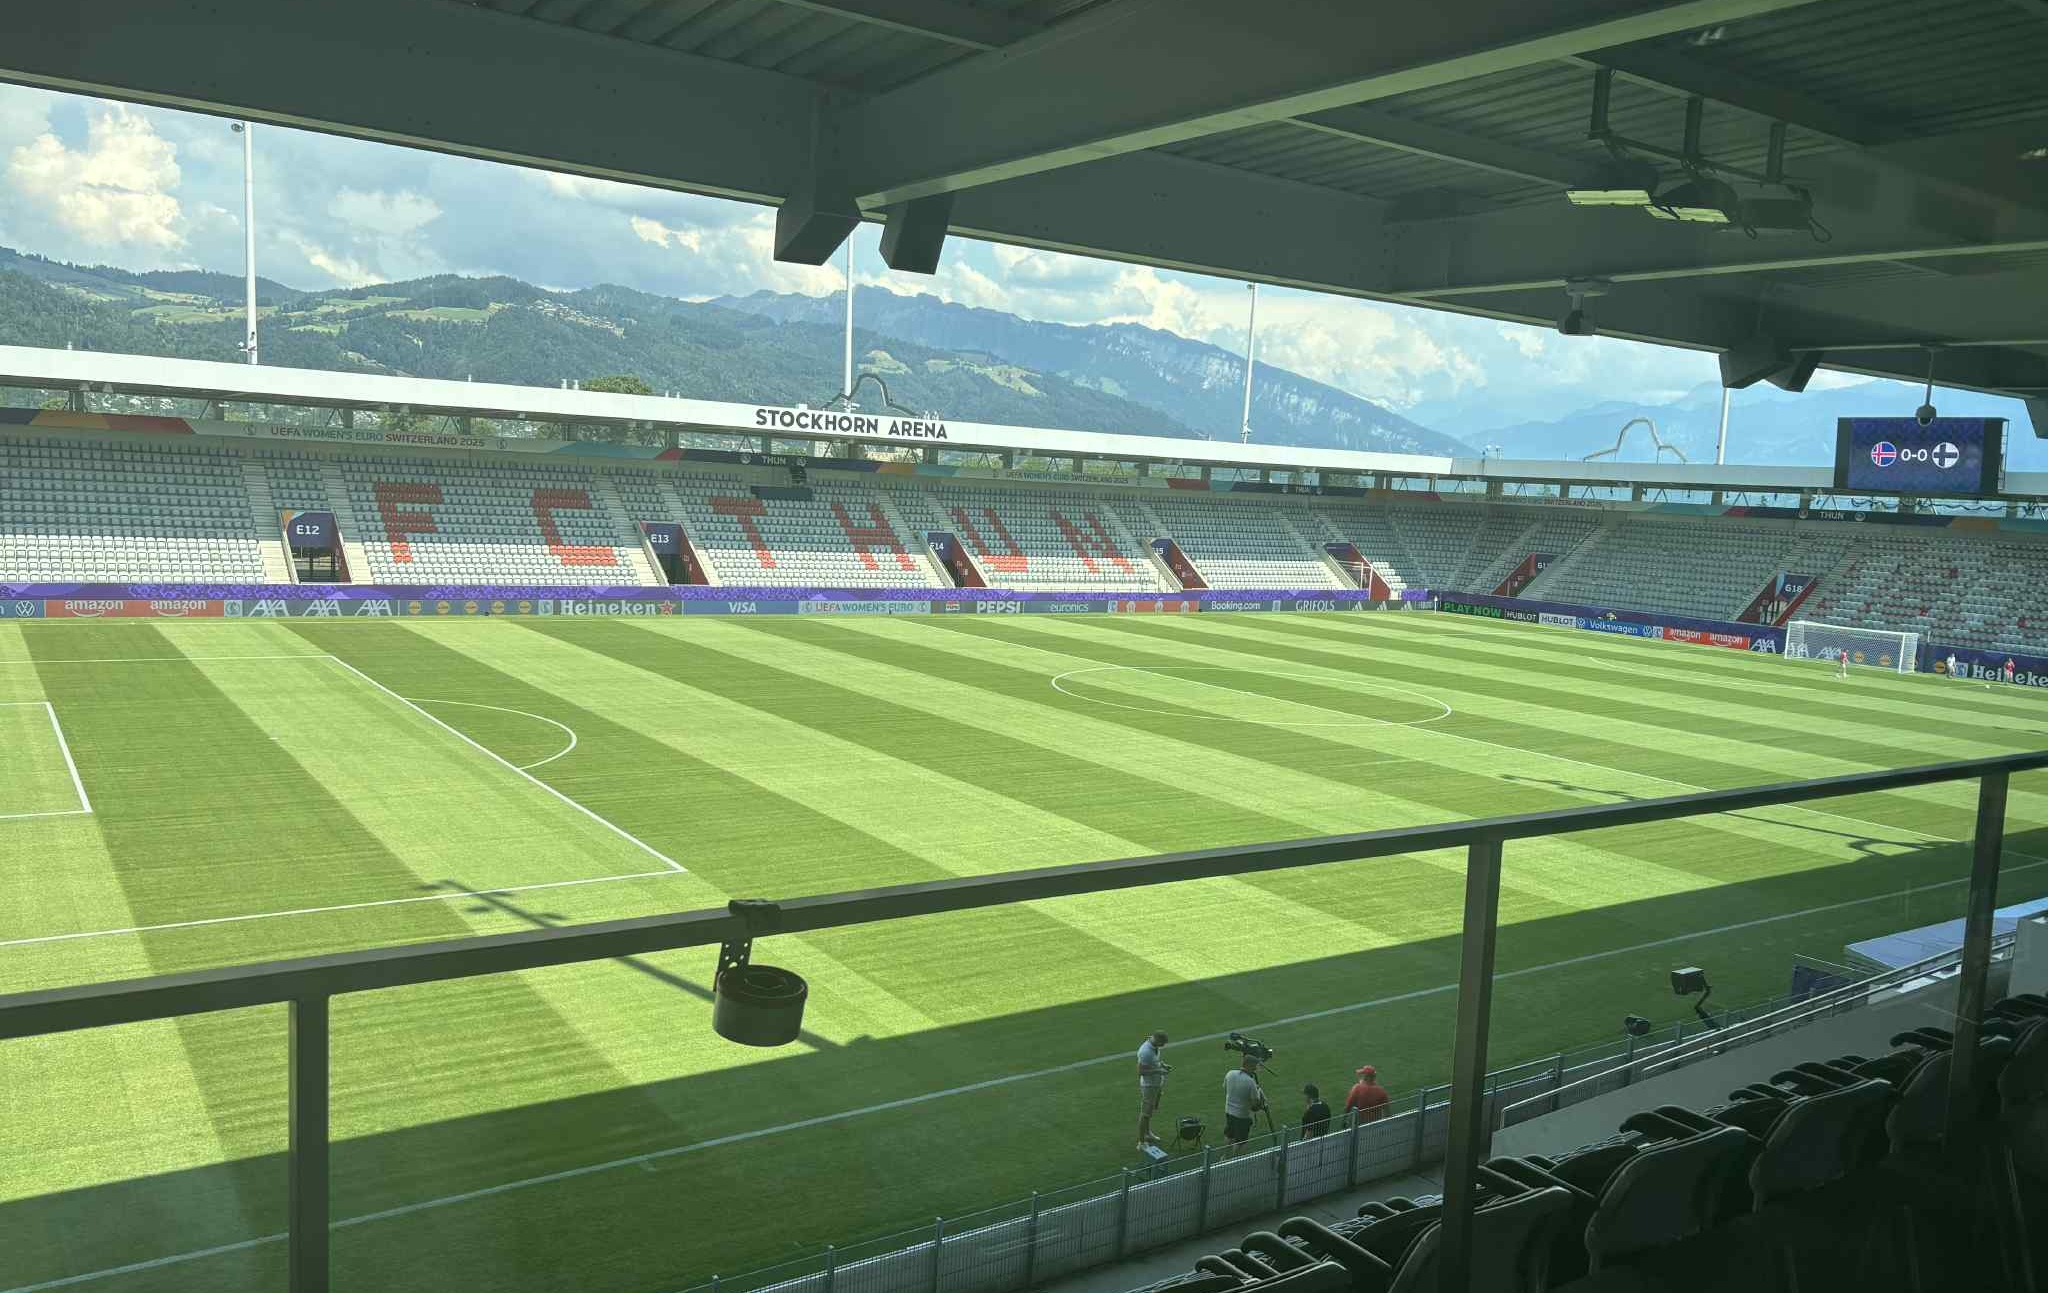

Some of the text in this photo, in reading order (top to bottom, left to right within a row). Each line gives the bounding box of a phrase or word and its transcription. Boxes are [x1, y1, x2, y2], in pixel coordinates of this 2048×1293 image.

[755, 408, 948, 439] STOCKHORN ARENA
[270, 426, 301, 437] UEFA
[355, 431, 383, 441] EURO
[385, 433, 458, 446] SWITZERLAND
[459, 438, 485, 448] 2025
[761, 455, 787, 466] THUN
[1900, 448, 1928, 462] 0-0
[1819, 511, 1845, 521] THUN
[296, 524, 320, 535] E12
[650, 533, 670, 543] E13
[64, 600, 207, 612] amazon amazon
[248, 600, 290, 617] AXA
[302, 600, 343, 617] AXA
[354, 600, 393, 617] AXA
[560, 600, 657, 616] Heineken
[728, 601, 757, 613] VISA
[815, 601, 841, 612] UEFA
[976, 601, 1021, 613] PEPSI
[1049, 602, 1089, 613] euronics
[1211, 601, 1261, 612] Booking.com
[1295, 600, 1335, 612] GRIFOLS
[1505, 609, 1574, 626] HUBLOT HUBLOT
[1589, 619, 1639, 634] Volkswagen
[1669, 628, 1743, 644] amazon amazon
[1751, 638, 1777, 653] AXA
